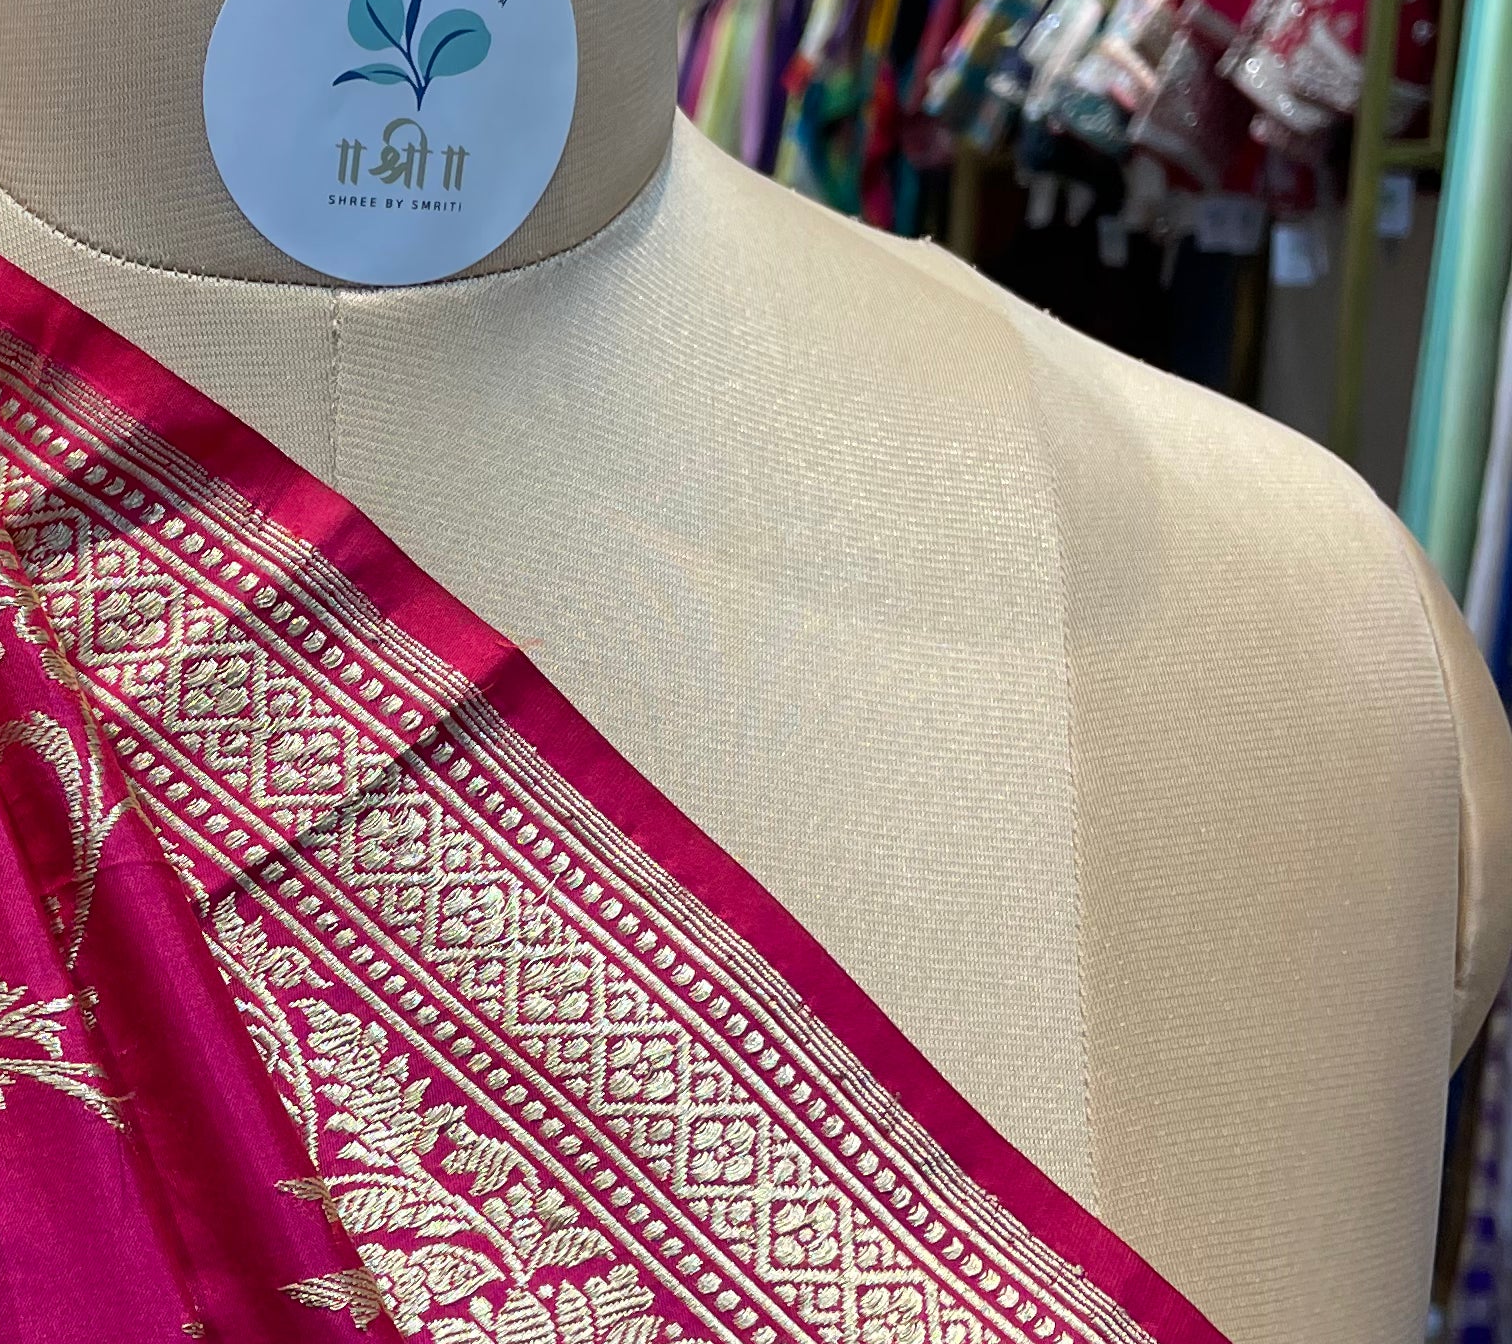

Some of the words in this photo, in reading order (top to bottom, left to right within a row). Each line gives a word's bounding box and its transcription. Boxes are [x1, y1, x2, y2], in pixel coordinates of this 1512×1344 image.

[328, 194, 377, 208] SHREE
[385, 198, 404, 209] BY
[411, 200, 463, 213] SMRITI
